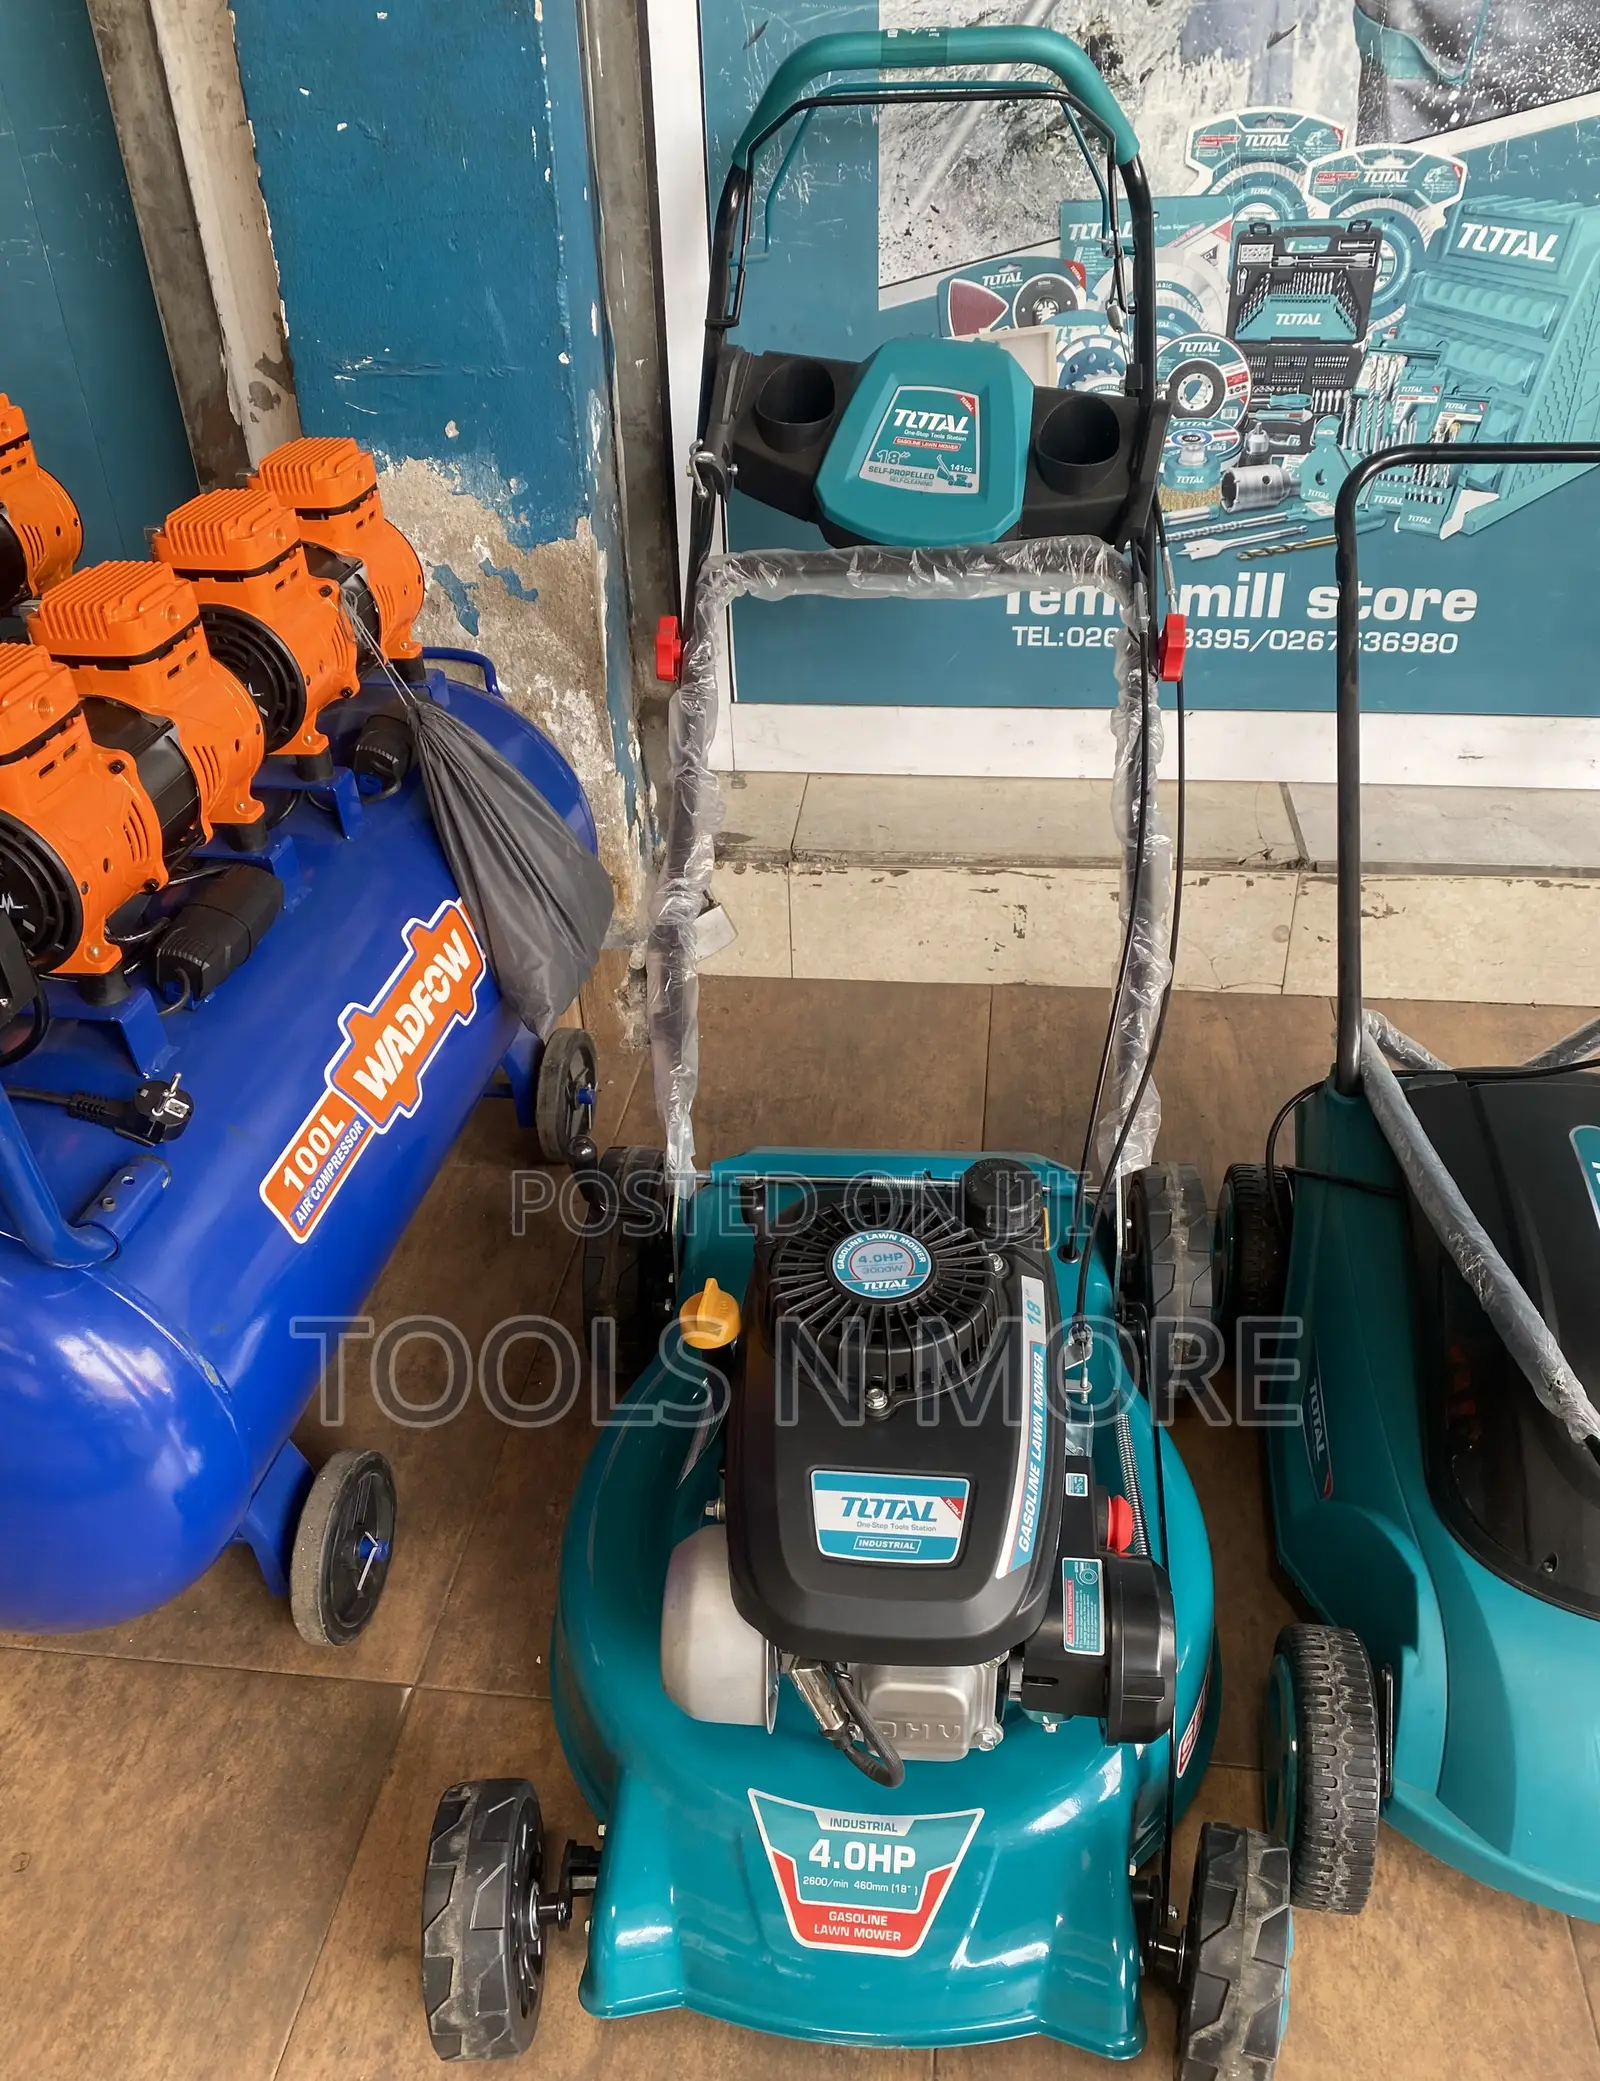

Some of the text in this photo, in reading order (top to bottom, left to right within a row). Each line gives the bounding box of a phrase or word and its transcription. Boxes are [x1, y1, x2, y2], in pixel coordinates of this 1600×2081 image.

[1245, 134, 1290, 147] TOTAL
[1363, 170, 1409, 183] TOTAL
[1457, 222, 1559, 263] TOTAL
[981, 272, 1023, 287] TOTAL
[1276, 313, 1322, 325] TOTAL
[1179, 342, 1221, 353] TOTAL
[894, 409, 969, 434] TOTAL
[868, 466, 935, 480] SELF-PROPELLED
[950, 464, 972, 473] 141cc
[1176, 475, 1205, 484] TOTAL
[1307, 488, 1330, 500] TOTAL
[1408, 514, 1432, 525] TOTAL
[283, 1113, 346, 1193] 100L
[295, 1120, 364, 1226] AIR COMPRESSOR
[837, 1237, 864, 1270] GASOLINE
[899, 1237, 927, 1263] MOWER
[858, 1252, 904, 1264] 4.0HP
[862, 1279, 909, 1290] TOTAL
[1309, 1376, 1325, 1462] TOTAL
[1019, 1351, 1045, 1553] GASOLINE LAWN MOWER
[841, 1496, 938, 1522] TOTAL
[945, 1498, 961, 1516] TOTAL
[856, 1521, 937, 1532] One-Stop Tools Station
[858, 1539, 916, 1550] INDUSTRIAL
[829, 1817, 898, 1833] INDUSTRIAL
[808, 1838, 916, 1874] 4.0HP
[802, 1875, 849, 1889] 2600/min
[853, 1880, 889, 1893] 460mm
[828, 1911, 888, 1926] GASOLINE
[814, 1923, 902, 1942] LAWN MOWER
